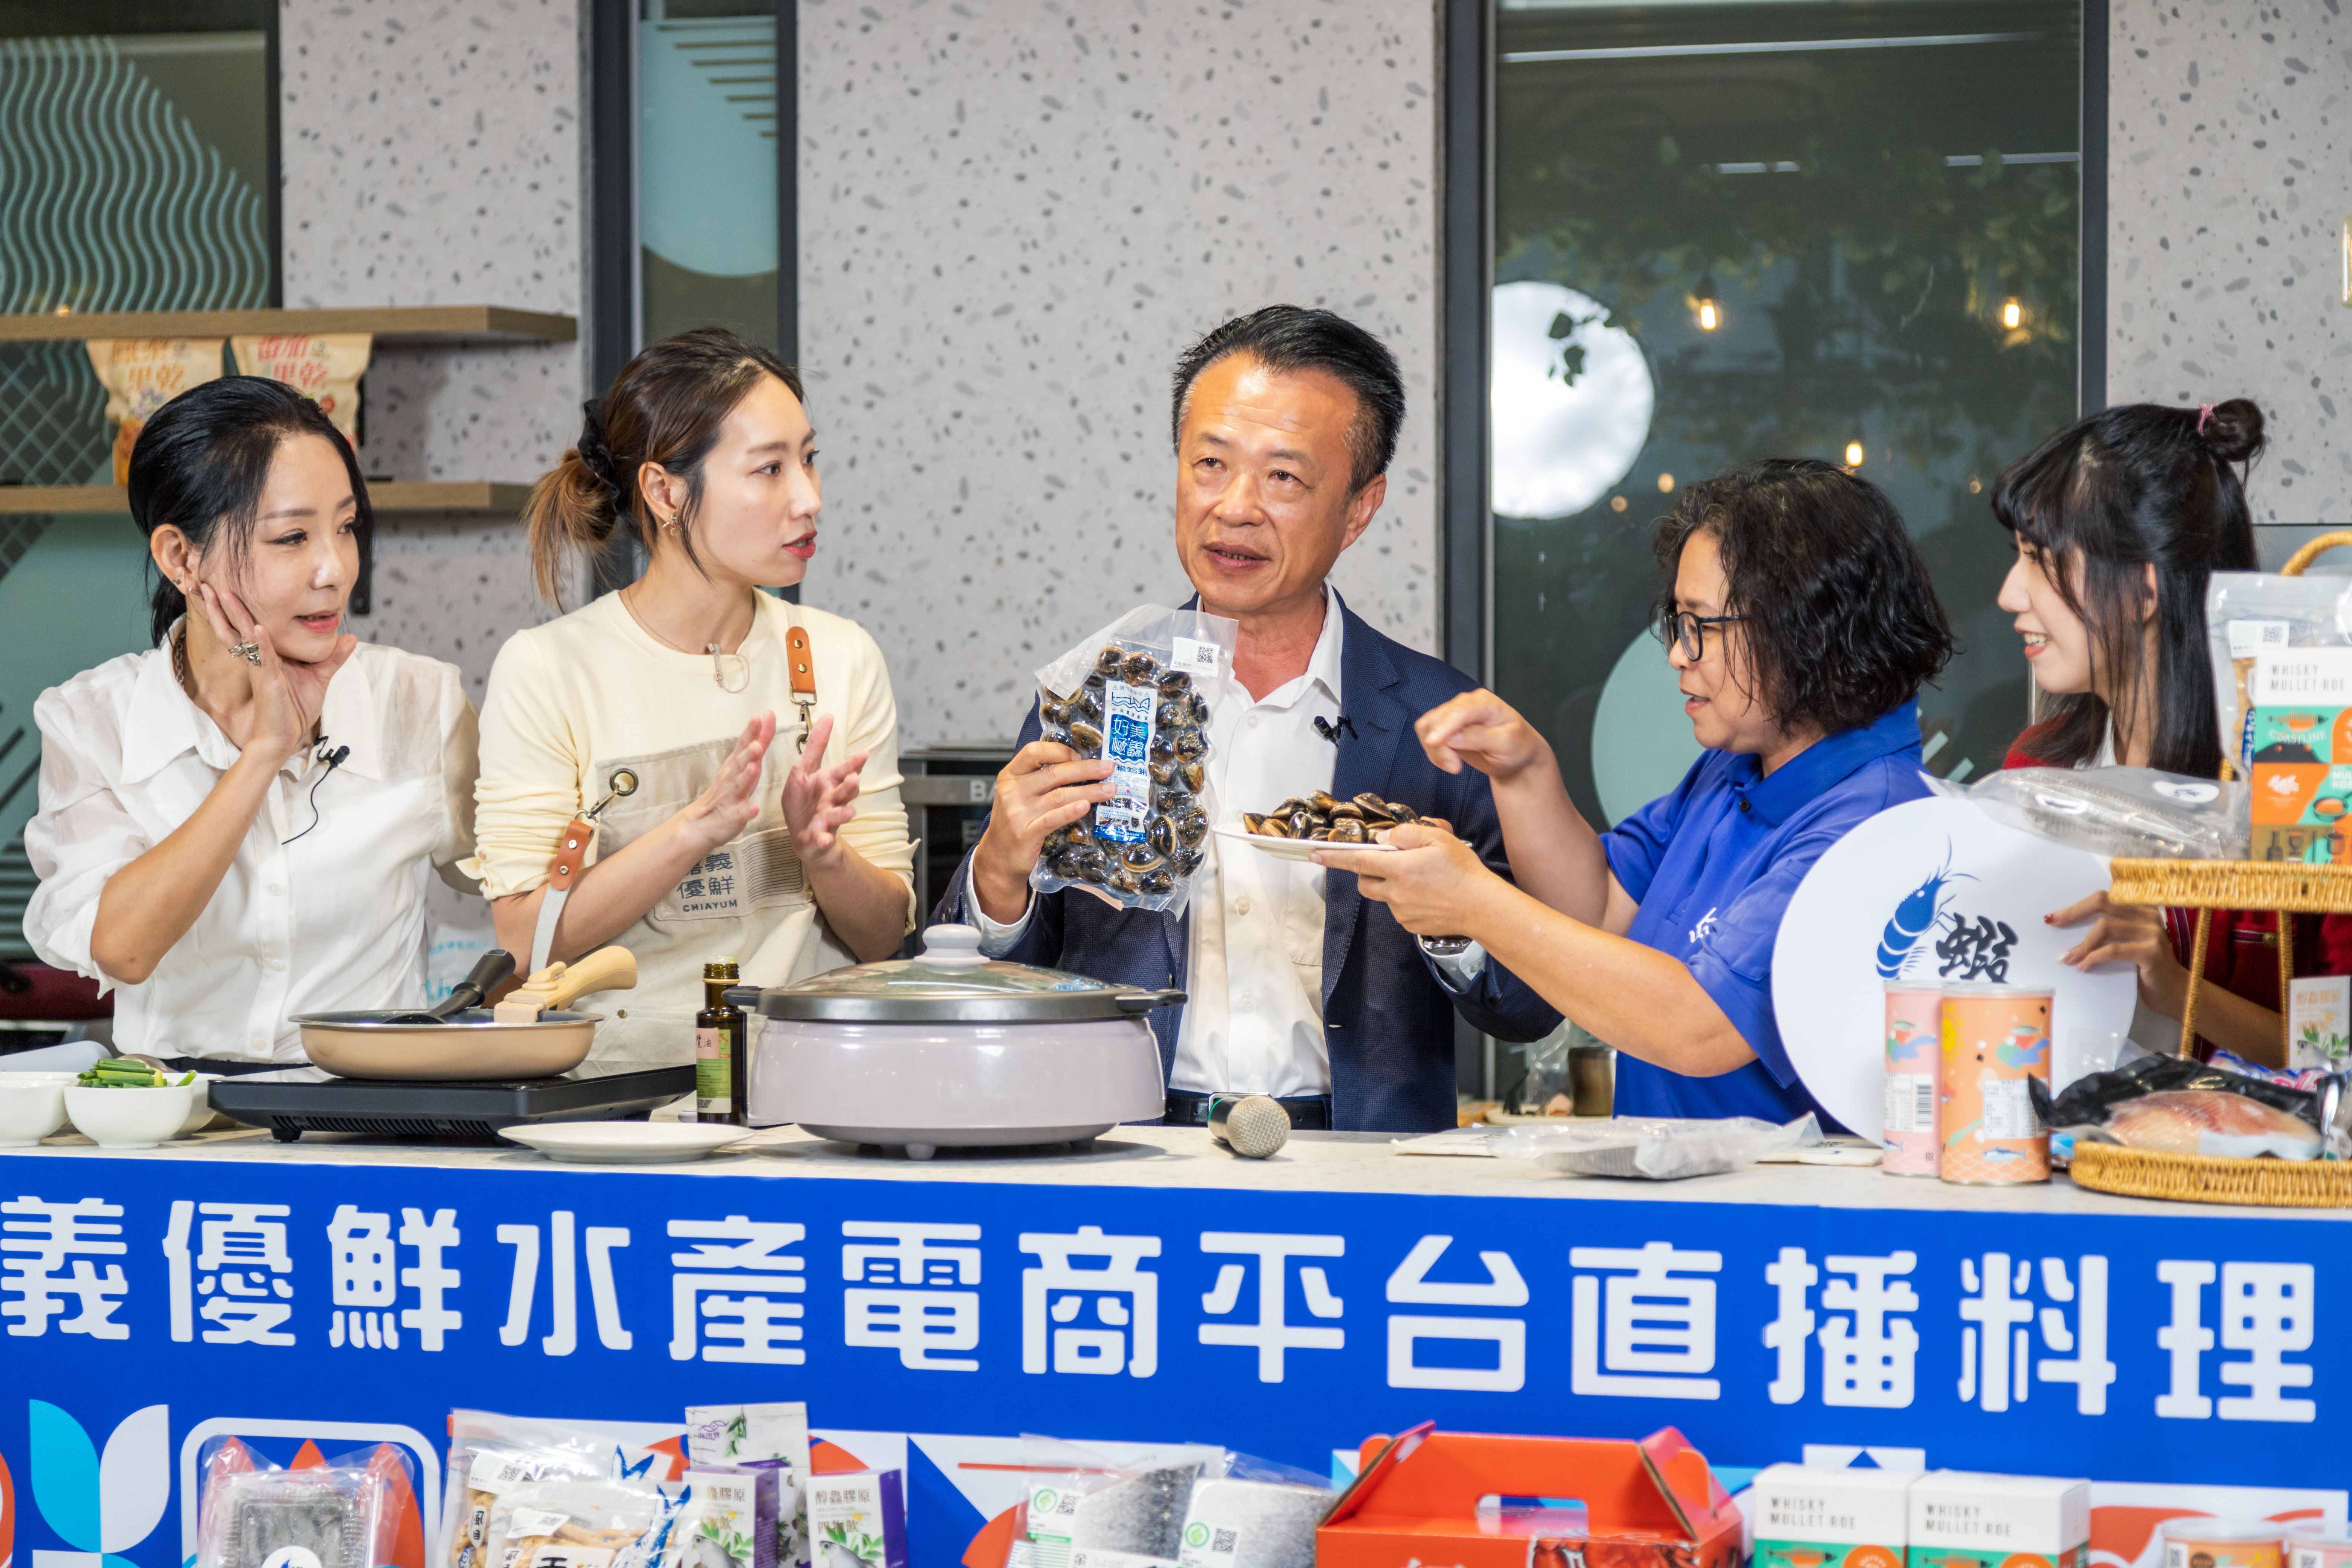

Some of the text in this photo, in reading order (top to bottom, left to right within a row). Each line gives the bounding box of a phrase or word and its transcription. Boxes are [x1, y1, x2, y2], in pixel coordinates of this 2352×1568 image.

[2272, 663, 2319, 676] WHISKY
[2271, 678, 2346, 691] MULLET ROE
[1113, 718, 1146, 740] 好美
[2268, 729, 2328, 744] COASTLINE
[1115, 764, 1147, 776] 級蛤蜊
[677, 875, 735, 899] 優鮮
[683, 899, 738, 912] CHIAYUM
[0, 1196, 2317, 1423] 義優鮮水產電商平台直播料理
[1771, 1497, 1826, 1511] WHISKY
[1926, 1504, 1981, 1518] WHISKY
[1770, 1513, 1856, 1529] MULLET ROE
[1926, 1519, 2012, 1537] MULLET ROE
